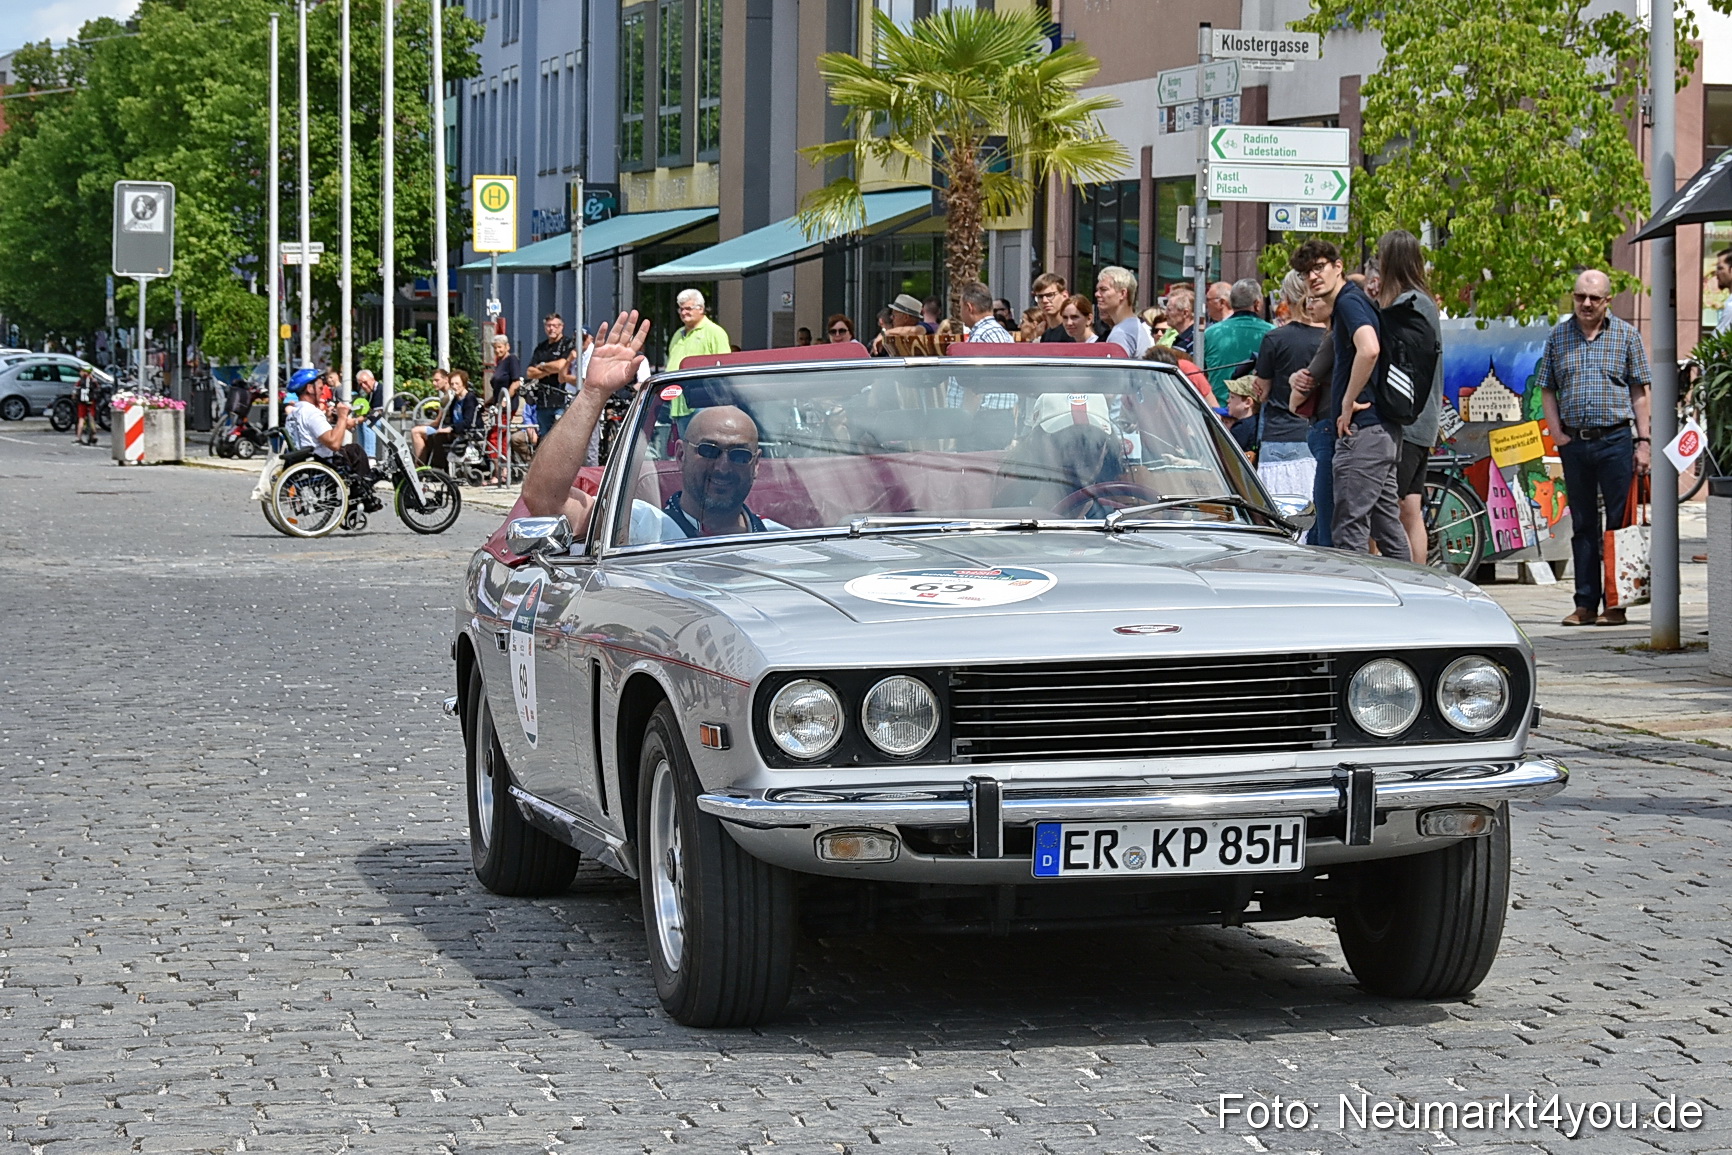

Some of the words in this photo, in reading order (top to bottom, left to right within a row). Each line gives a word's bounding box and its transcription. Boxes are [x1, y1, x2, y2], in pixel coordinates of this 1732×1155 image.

[1221, 34, 1309, 56] Klostergasse
[1243, 133, 1279, 144] Radinfo
[1243, 146, 1297, 157] Ladestation
[1216, 171, 1240, 182] Kastl
[1304, 174, 1314, 184] 26
[1216, 183, 1248, 194] Pilsach
[488, 189, 501, 206] H
[585, 198, 604, 220] G2
[134, 222, 153, 230] ZONE
[910, 582, 974, 593] 69
[1063, 830, 1119, 870] ER
[1151, 827, 1208, 868] KP
[1218, 823, 1301, 866] 85H
[1042, 855, 1053, 867] D
